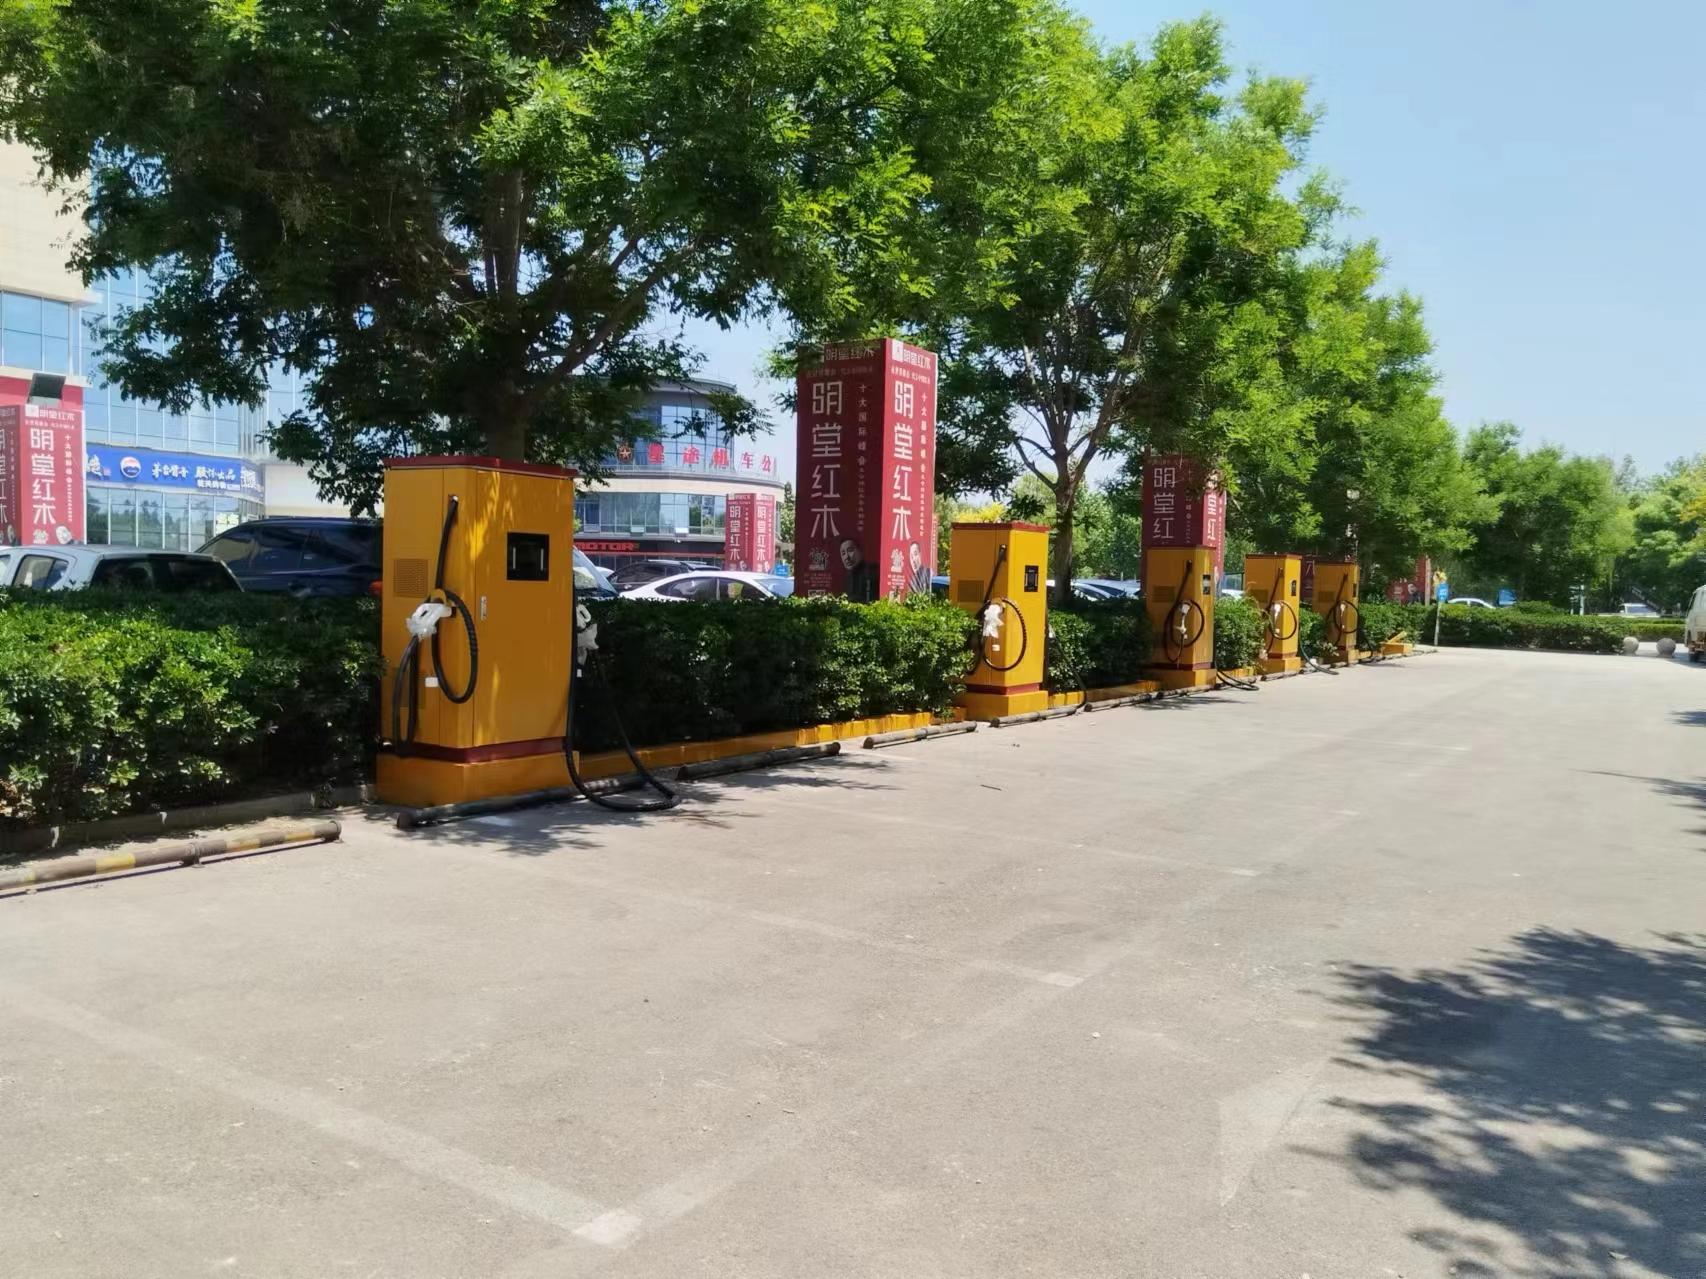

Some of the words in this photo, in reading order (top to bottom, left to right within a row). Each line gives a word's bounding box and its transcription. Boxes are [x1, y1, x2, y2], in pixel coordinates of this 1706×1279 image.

[31, 428, 57, 525] 明堂红木
[811, 381, 842, 539] 明堂红木
[893, 380, 914, 541] 明堂红木
